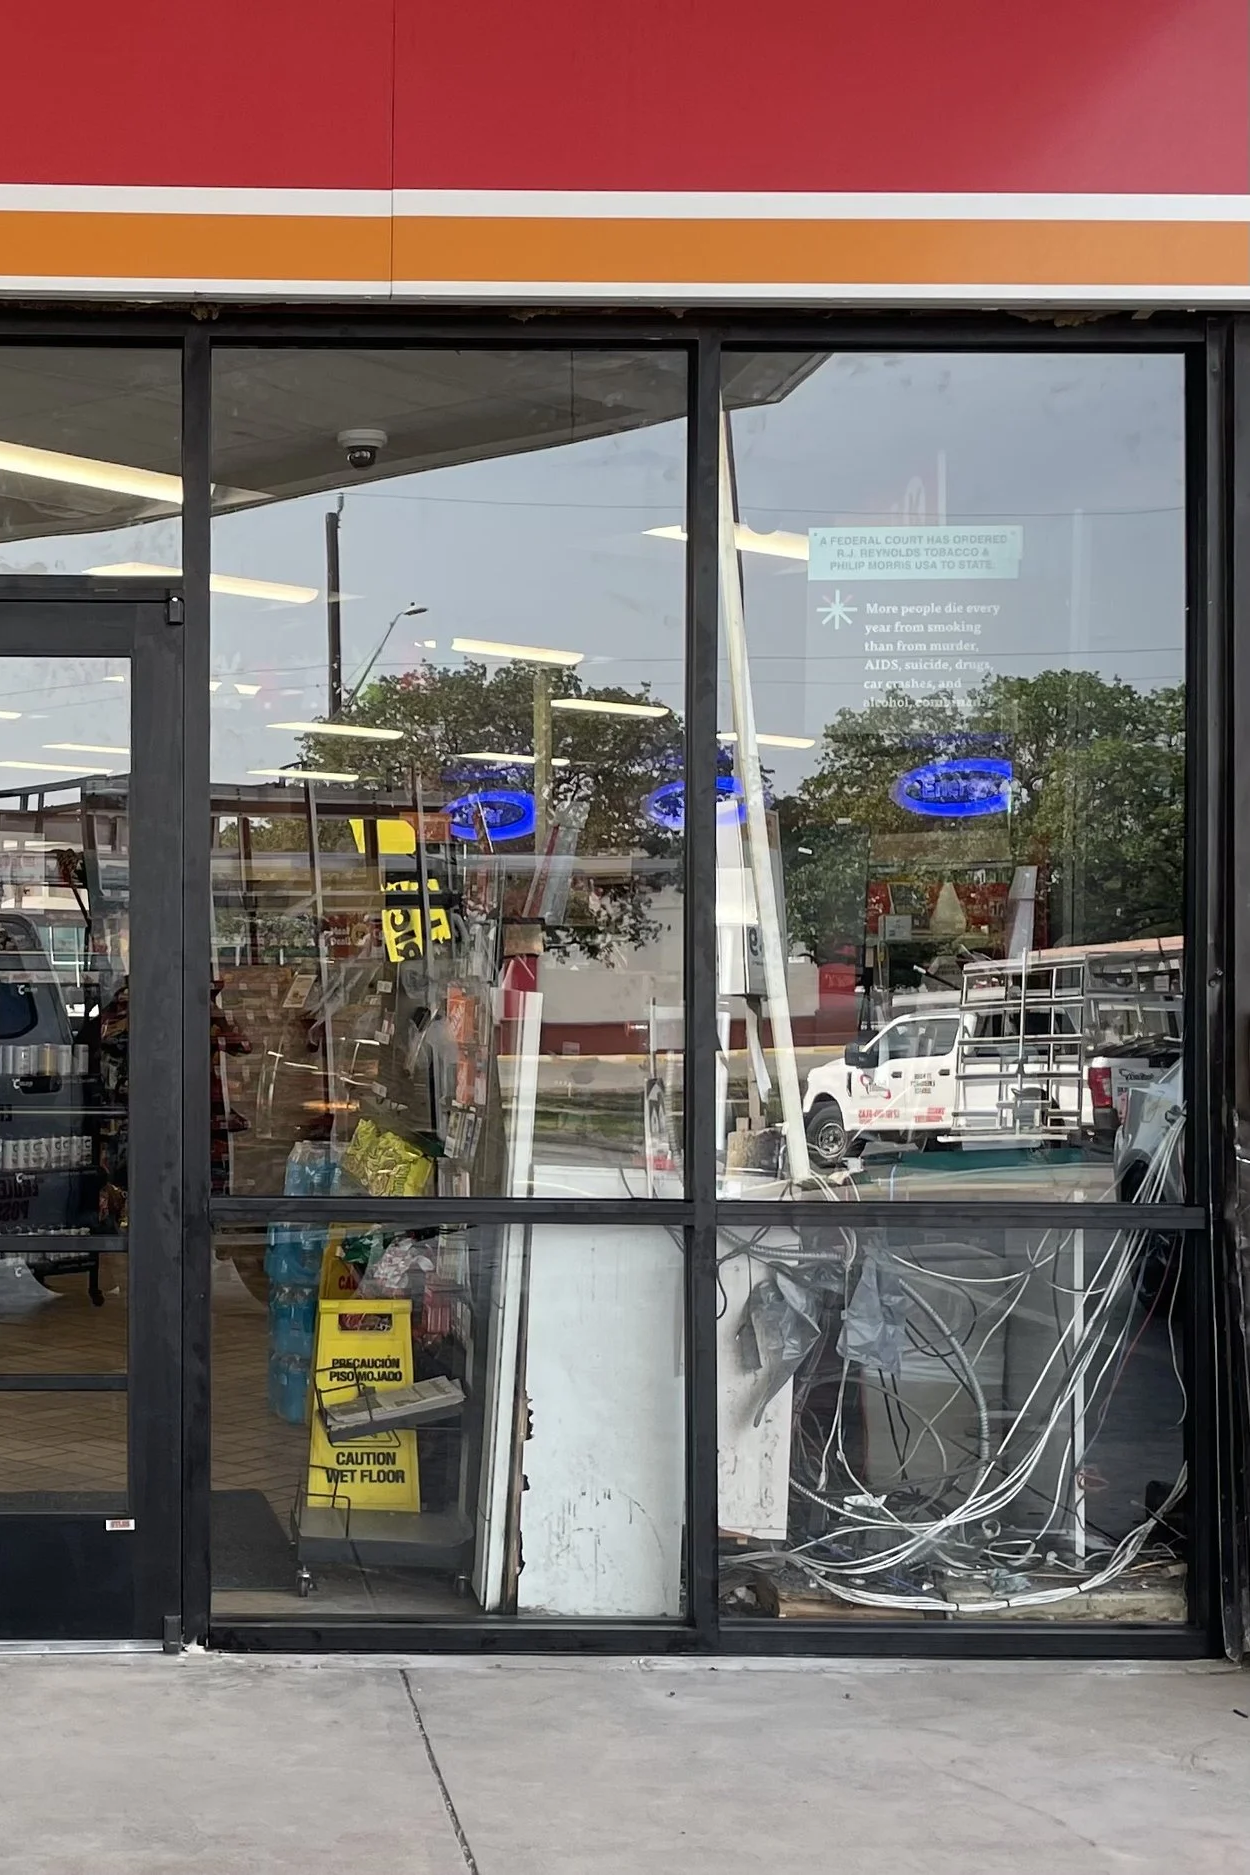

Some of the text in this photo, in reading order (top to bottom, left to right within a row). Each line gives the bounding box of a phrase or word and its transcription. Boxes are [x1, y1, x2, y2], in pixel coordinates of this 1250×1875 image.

[820, 534, 1007, 546] A FEDERAL COURT HAS ORDERED
[860, 548, 920, 558] REYNOLDS
[924, 547, 979, 557] TOBACCO
[982, 547, 989, 557] &
[830, 561, 865, 571] PHILIP
[868, 560, 911, 570] MORRIS
[915, 560, 937, 570] USA
[940, 560, 955, 569] TO
[866, 602, 1000, 616] More people die every
[864, 621, 982, 635] year from smoking
[864, 641, 979, 653] than from murder,
[864, 659, 994, 672] AIDS, suicide, drugs,
[864, 678, 962, 690] car crashes, and
[332, 1355, 400, 1369] PRECAUCIÓN
[330, 1371, 402, 1382] PISO MOJADO
[336, 1452, 396, 1465] CAUTION
[326, 1469, 405, 1483] WET FLOOR
